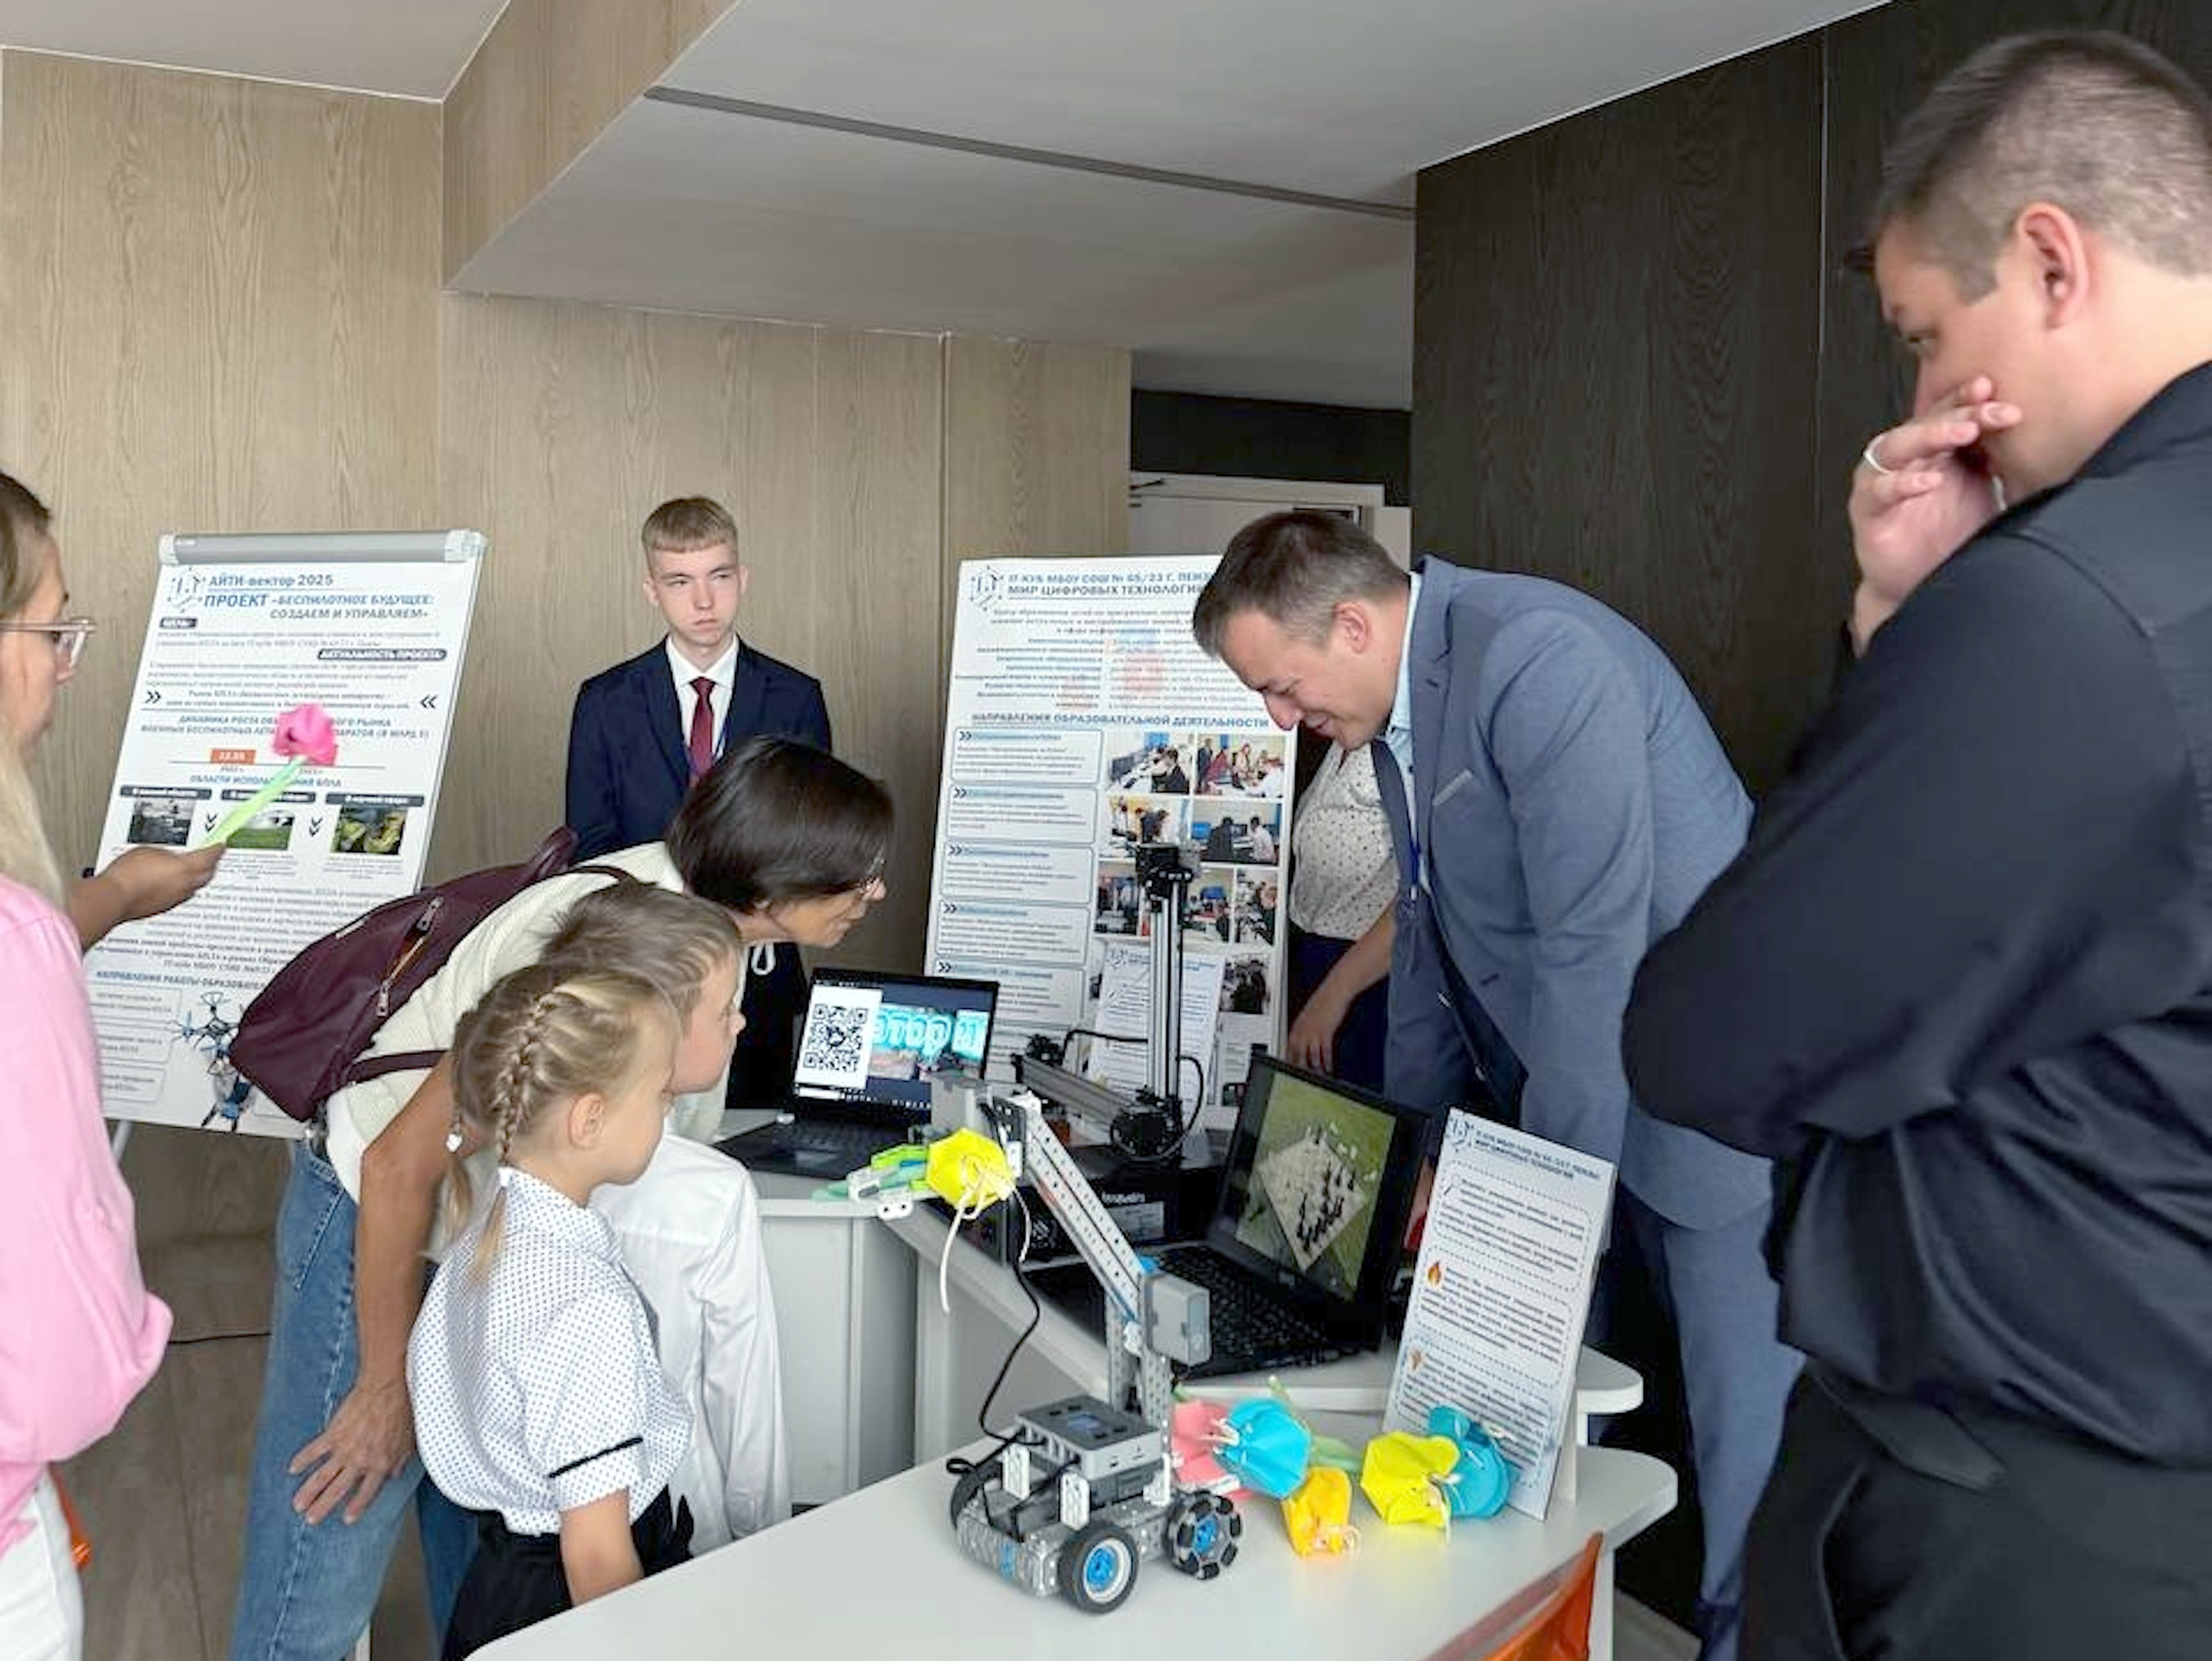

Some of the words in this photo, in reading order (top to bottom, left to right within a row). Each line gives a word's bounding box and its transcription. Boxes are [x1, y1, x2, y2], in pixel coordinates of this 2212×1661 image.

[209, 572, 295, 588] АЙТИ-вектор
[297, 574, 334, 586] 2025
[1178, 571, 1211, 582] ПЕНЗ
[1008, 585, 1038, 595] МИР
[1041, 585, 1118, 596] ЦИФРОВЫХ
[204, 595, 270, 608] ПРОЕКТ
[270, 608, 331, 620] СОЗДАЕМ
[333, 609, 342, 619] И
[1054, 715, 1167, 726] ОБРАЗОВАТЕЛЬНОЙ
[1172, 716, 1269, 728] ДЕЯТЕЛЬНОСТИ
